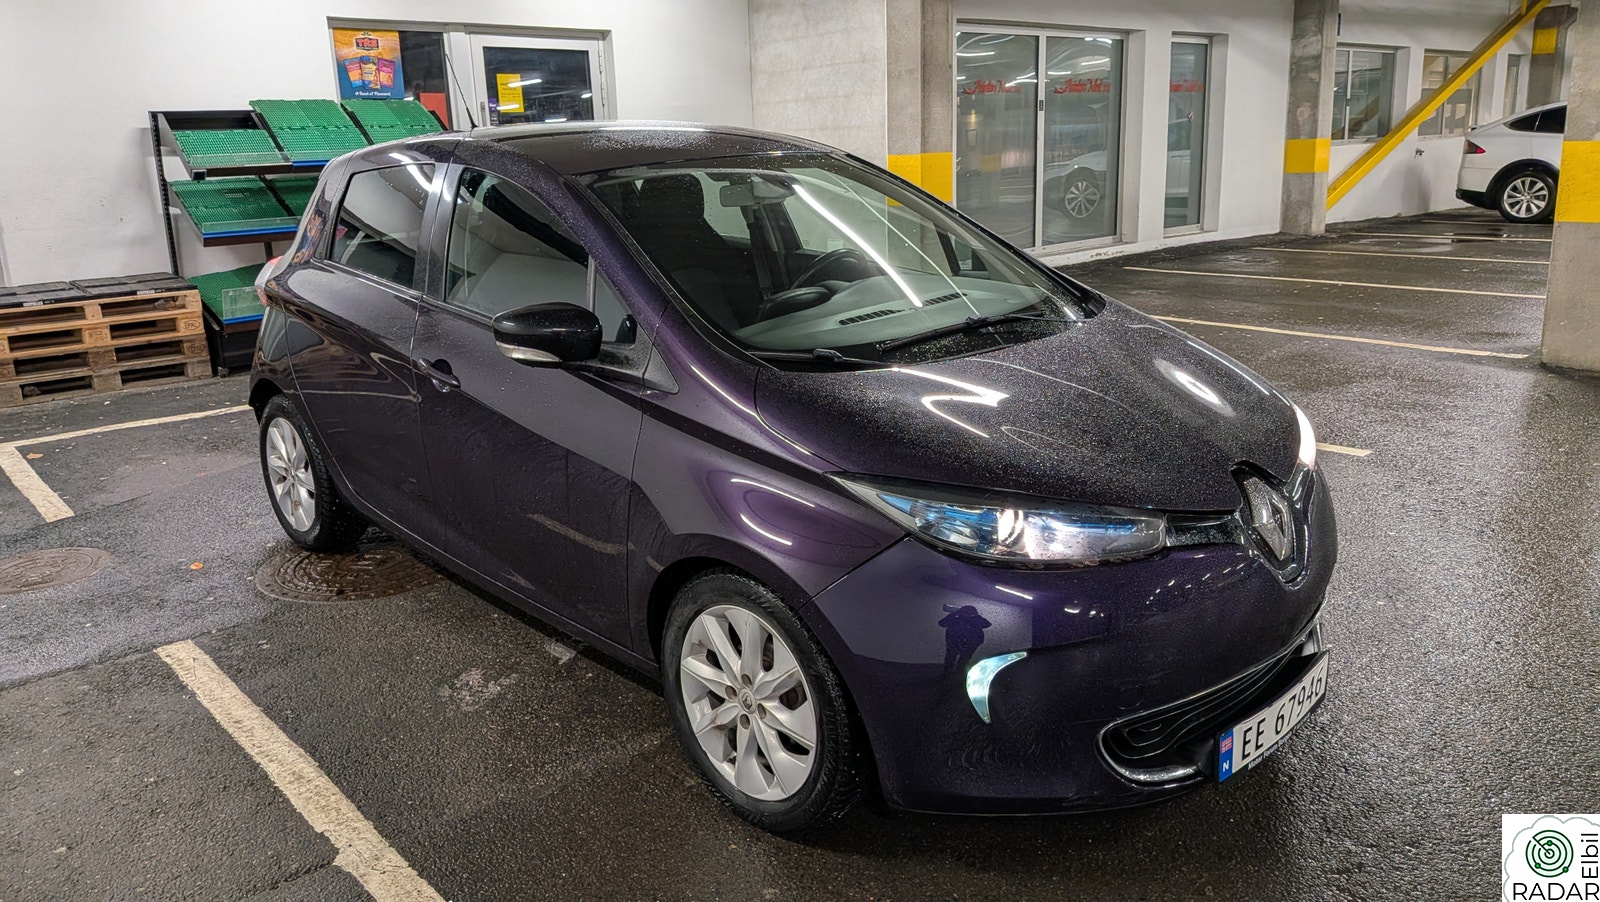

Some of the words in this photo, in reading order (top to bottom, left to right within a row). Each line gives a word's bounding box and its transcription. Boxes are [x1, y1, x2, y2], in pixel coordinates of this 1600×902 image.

[357, 38, 377, 47] TRS
[1241, 717, 1266, 762] EE
[1275, 666, 1324, 735] 67946
[1222, 760, 1230, 772] N
